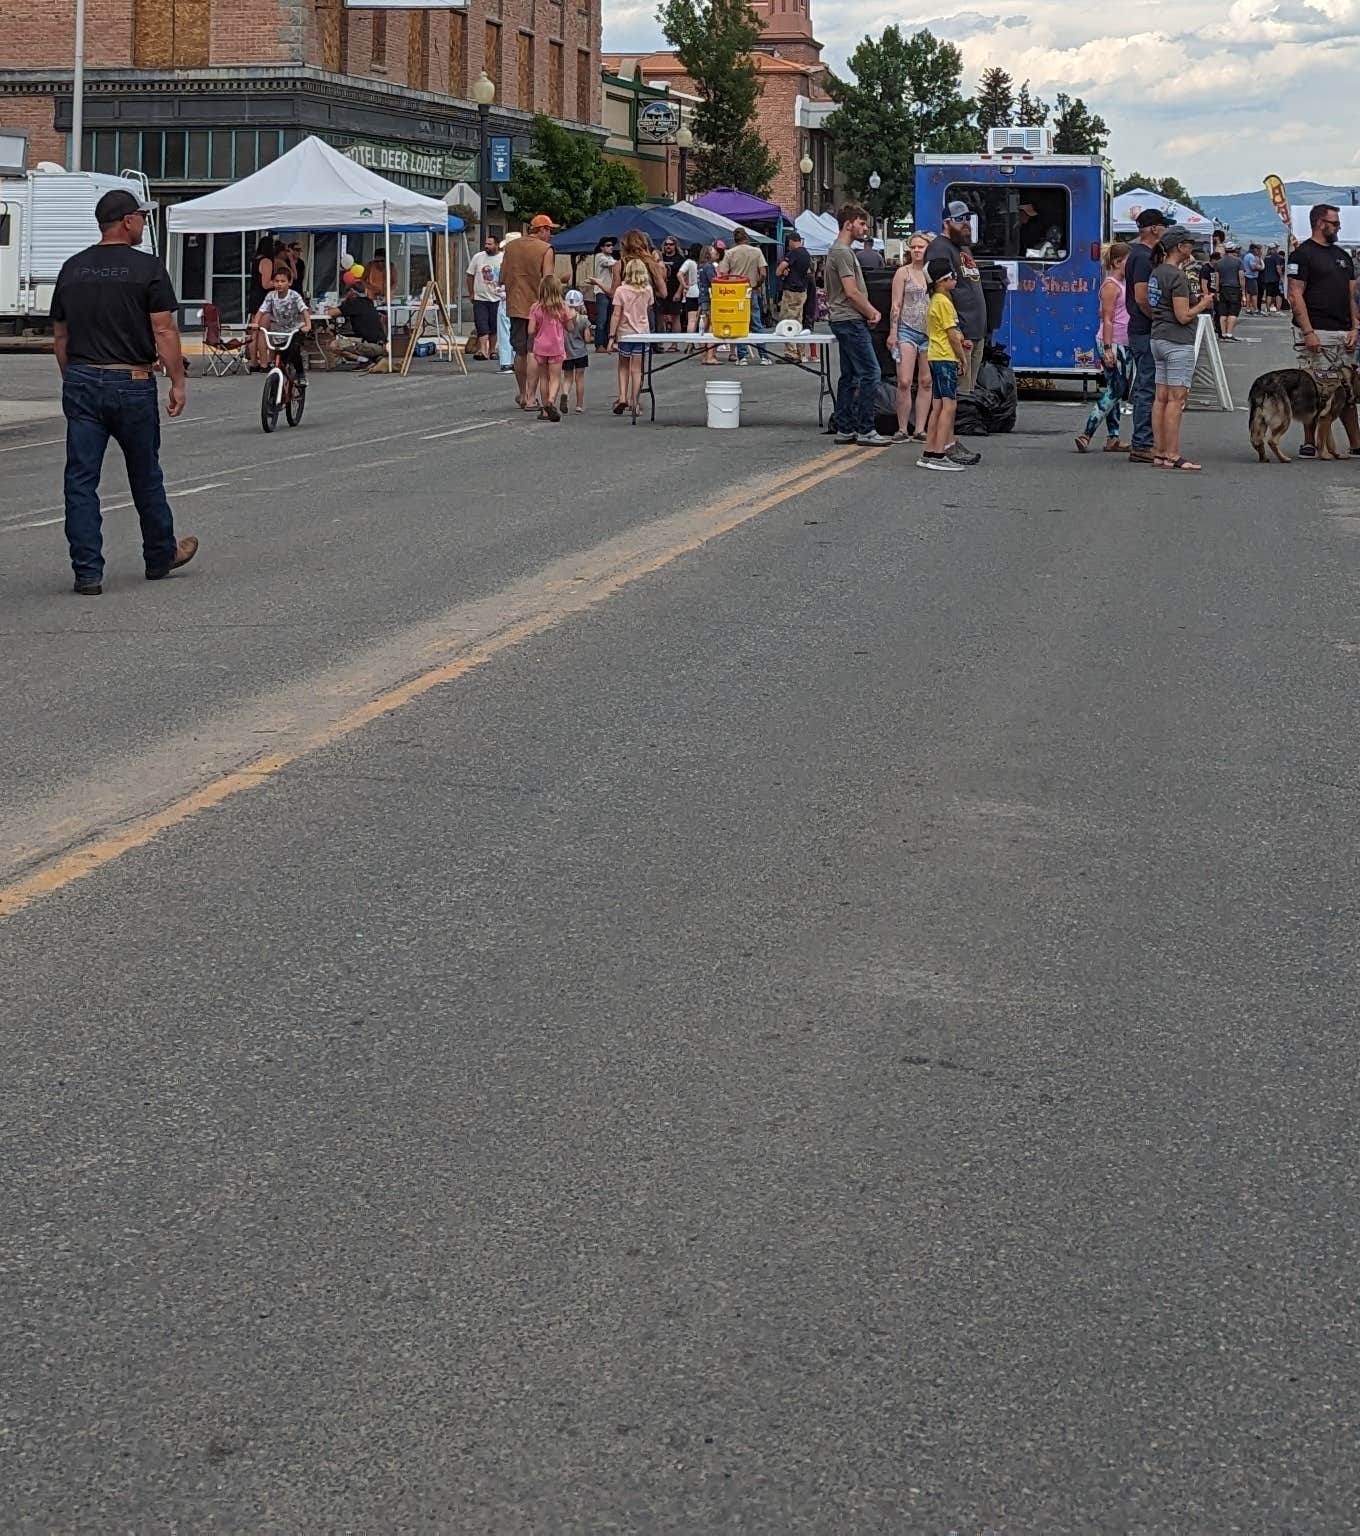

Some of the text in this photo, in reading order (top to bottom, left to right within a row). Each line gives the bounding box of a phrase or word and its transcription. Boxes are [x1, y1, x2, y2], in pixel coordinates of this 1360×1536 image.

[380, 148, 408, 171] DEER
[410, 152, 442, 176] LODGE
[1042, 273, 1088, 294] Shack
